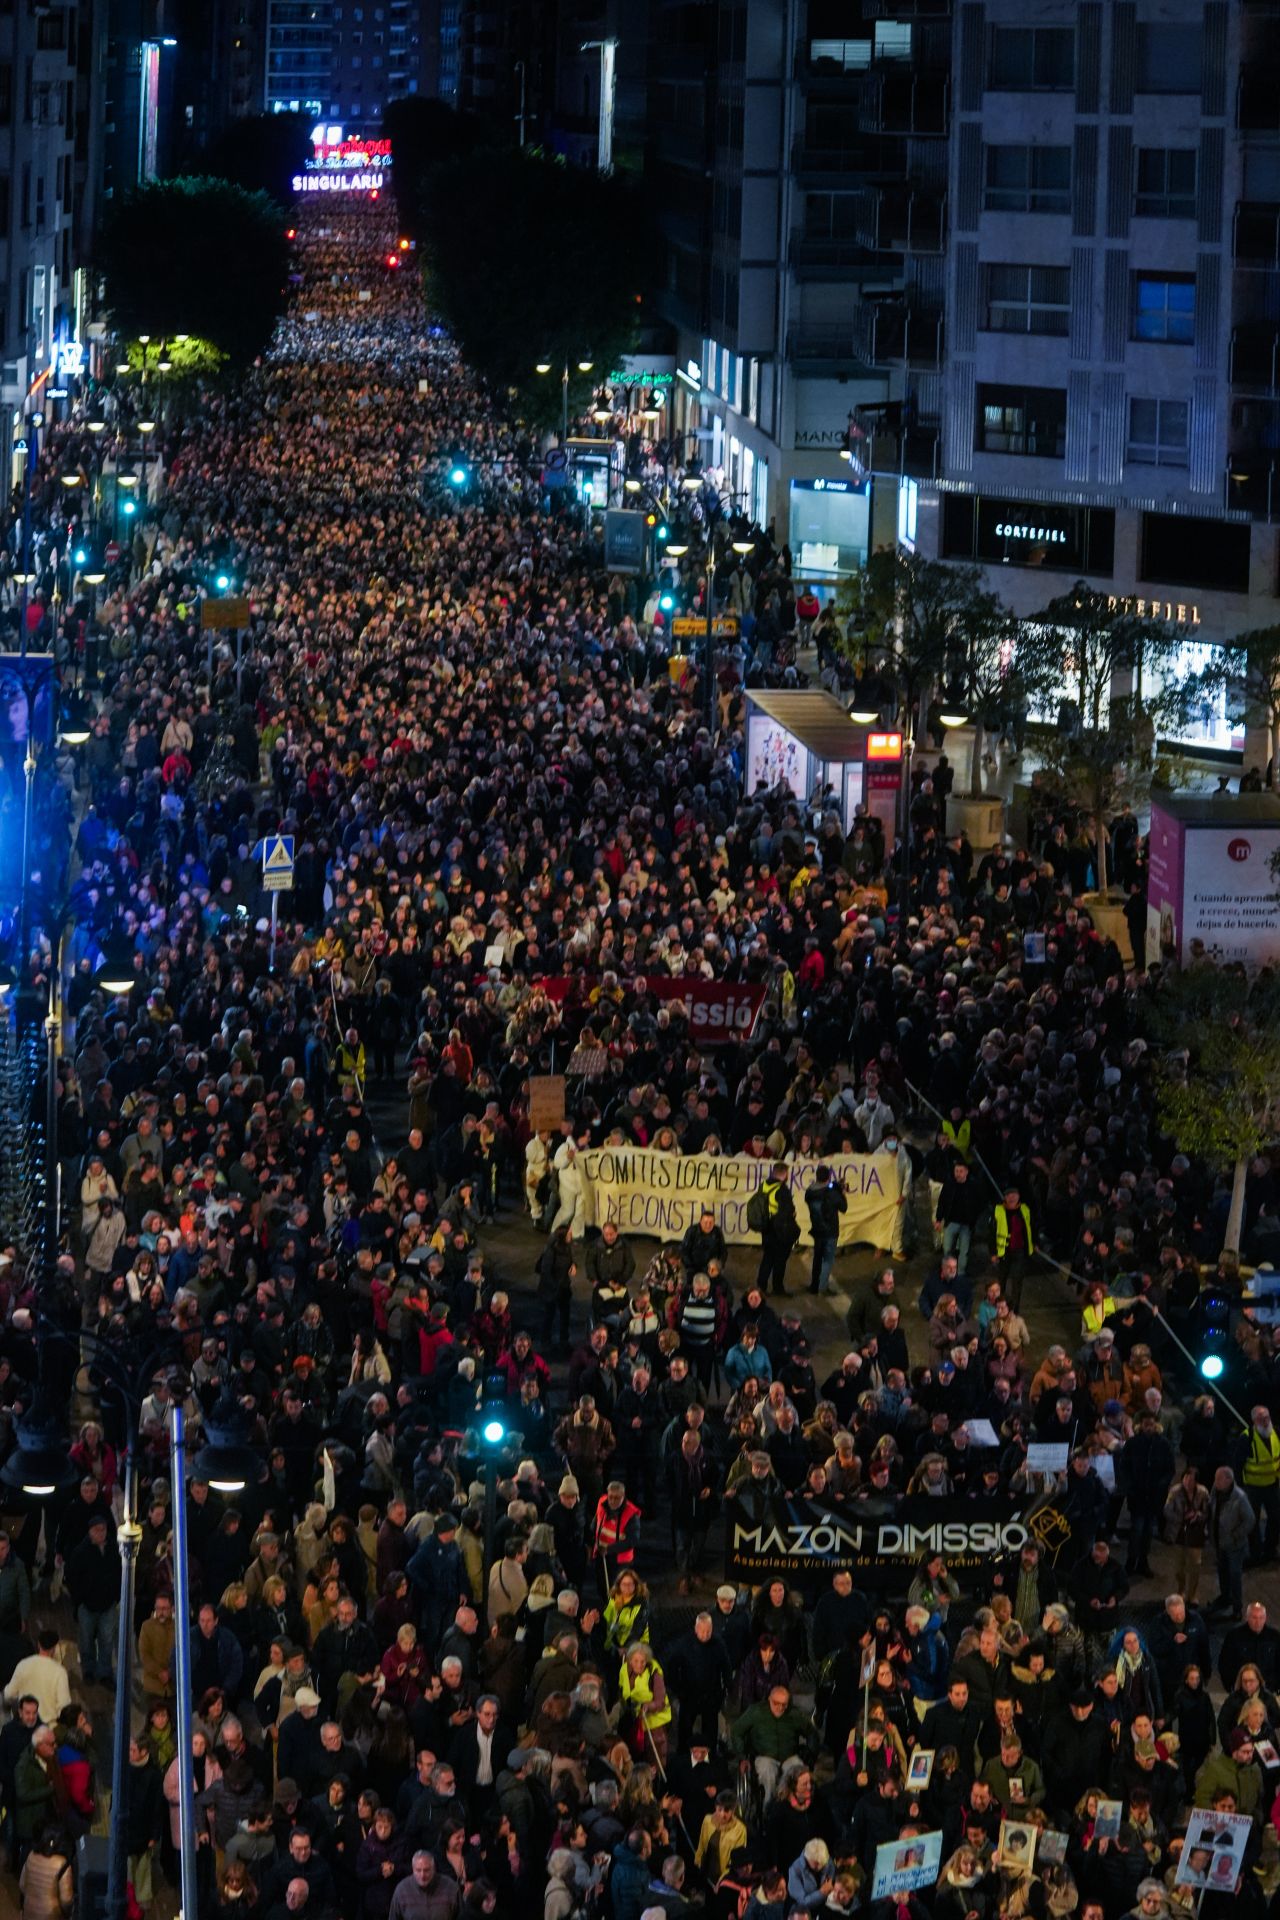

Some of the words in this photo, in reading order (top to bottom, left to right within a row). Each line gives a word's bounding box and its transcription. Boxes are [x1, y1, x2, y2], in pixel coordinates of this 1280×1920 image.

[292, 173, 384, 191] SINGULARU
[995, 523, 1067, 543] CORTEFIEL
[1194, 893, 1232, 903] Cuando
[1207, 907, 1240, 917] crecer,
[1197, 919, 1222, 931] dejas
[1223, 919, 1236, 929] de
[1237, 919, 1278, 929] hacerlo.
[675, 1159, 740, 1191] LOCALS
[733, 1513, 863, 1555] MAZÓN
[877, 1510, 1029, 1555] DIMISSIÓ
